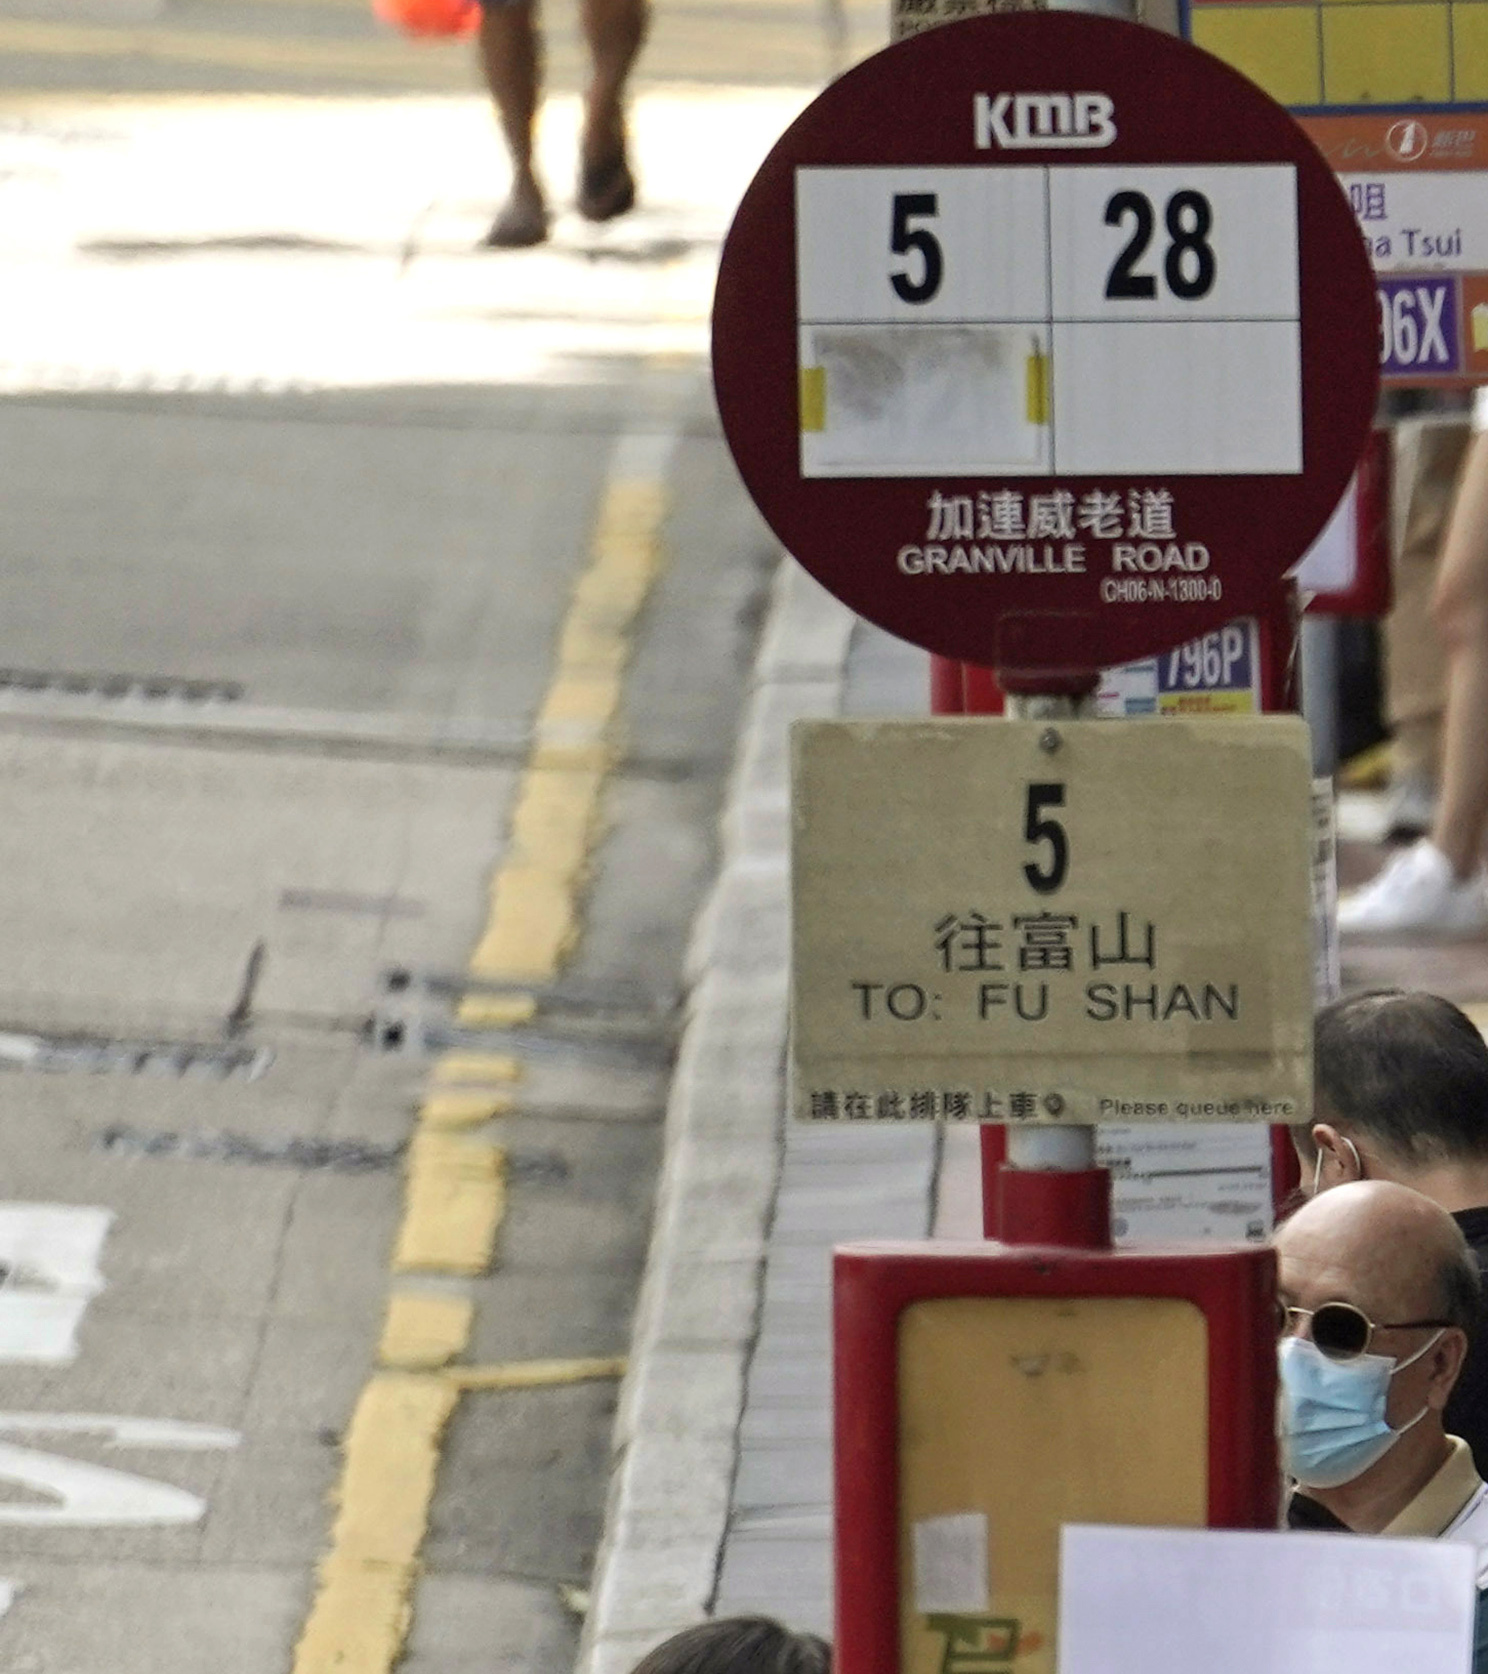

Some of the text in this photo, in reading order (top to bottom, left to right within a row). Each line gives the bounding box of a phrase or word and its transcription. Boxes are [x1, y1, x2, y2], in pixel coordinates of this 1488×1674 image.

[973, 91, 1118, 150] KMB
[890, 188, 1217, 305] 5 28
[1401, 227, 1463, 257] Tsui
[925, 487, 1178, 541] 加連威老道
[898, 541, 1211, 575] GRANVILLE ROAD
[1023, 782, 1069, 895] 5
[934, 909, 1158, 974] 往富山
[851, 980, 1240, 1022] TO: FU SHAN
[1099, 1098, 1295, 1119] Please queue here
